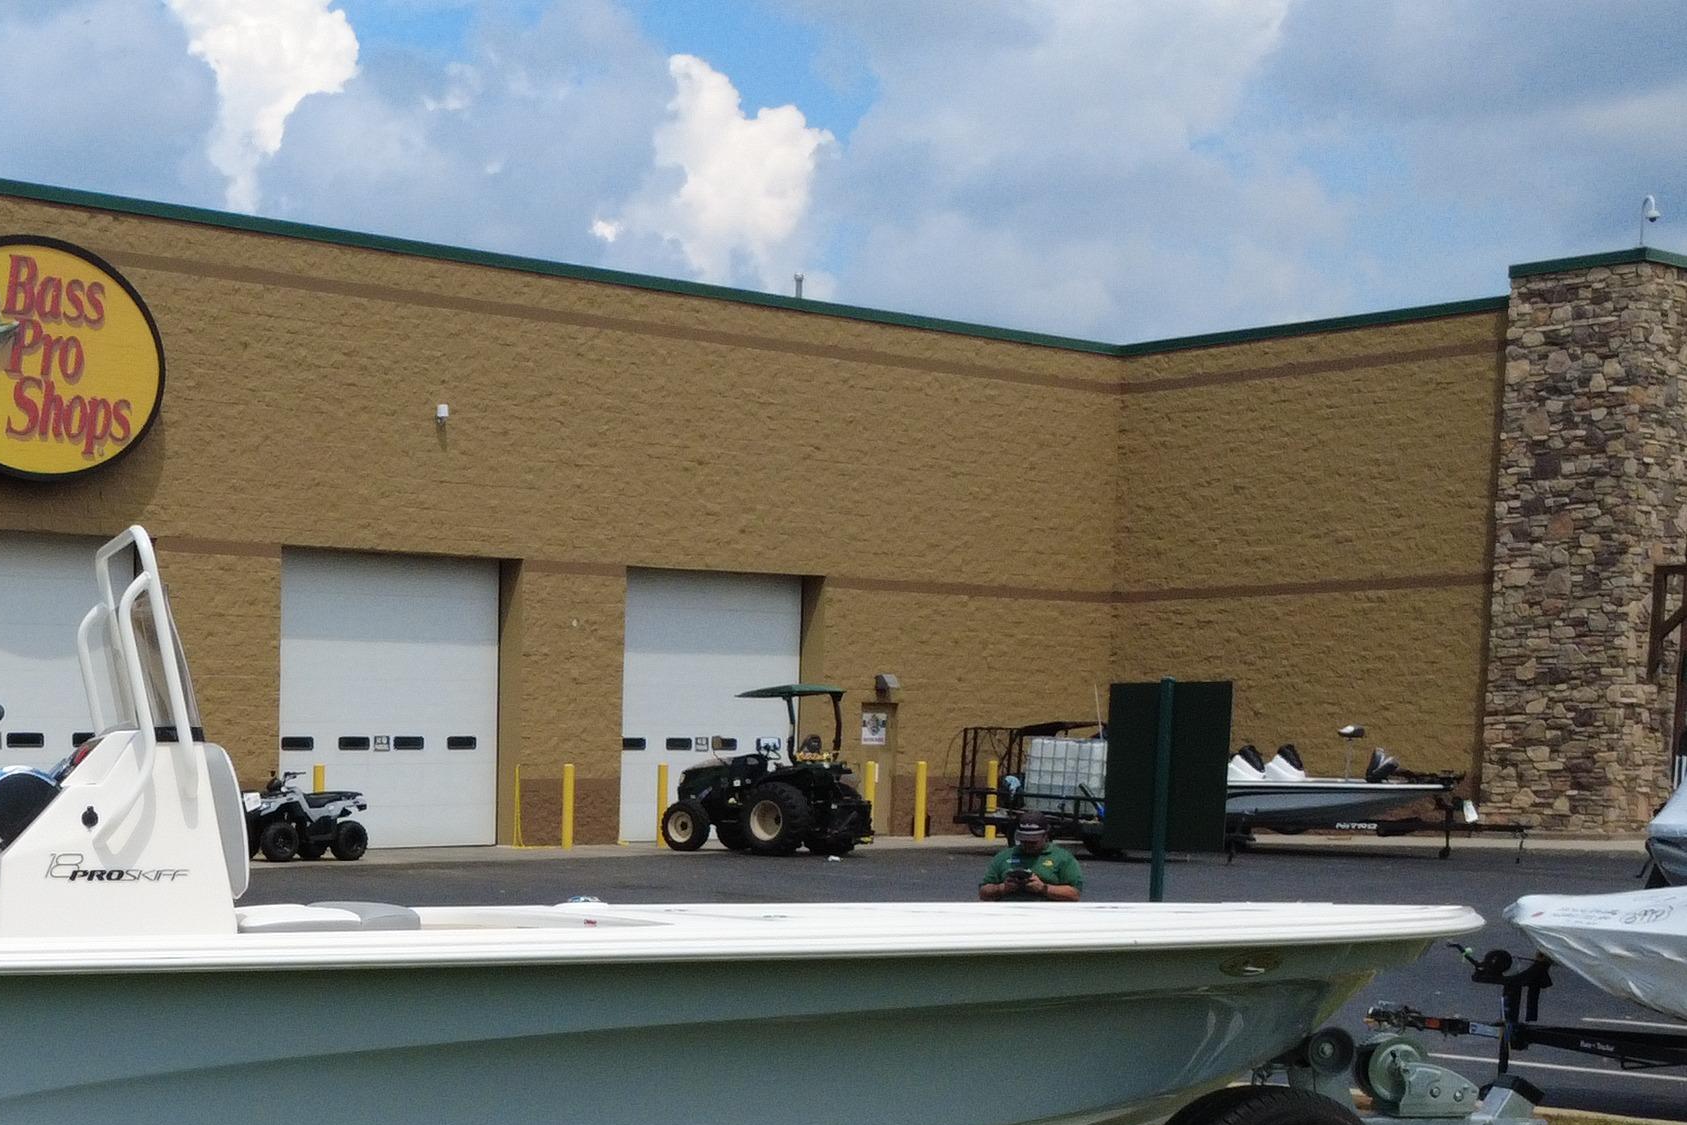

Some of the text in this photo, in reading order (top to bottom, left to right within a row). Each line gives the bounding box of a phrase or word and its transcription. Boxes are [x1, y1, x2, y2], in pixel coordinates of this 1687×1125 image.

[1, 255, 106, 330] Bass
[4, 320, 85, 384] Pro
[5, 376, 133, 460] Shops
